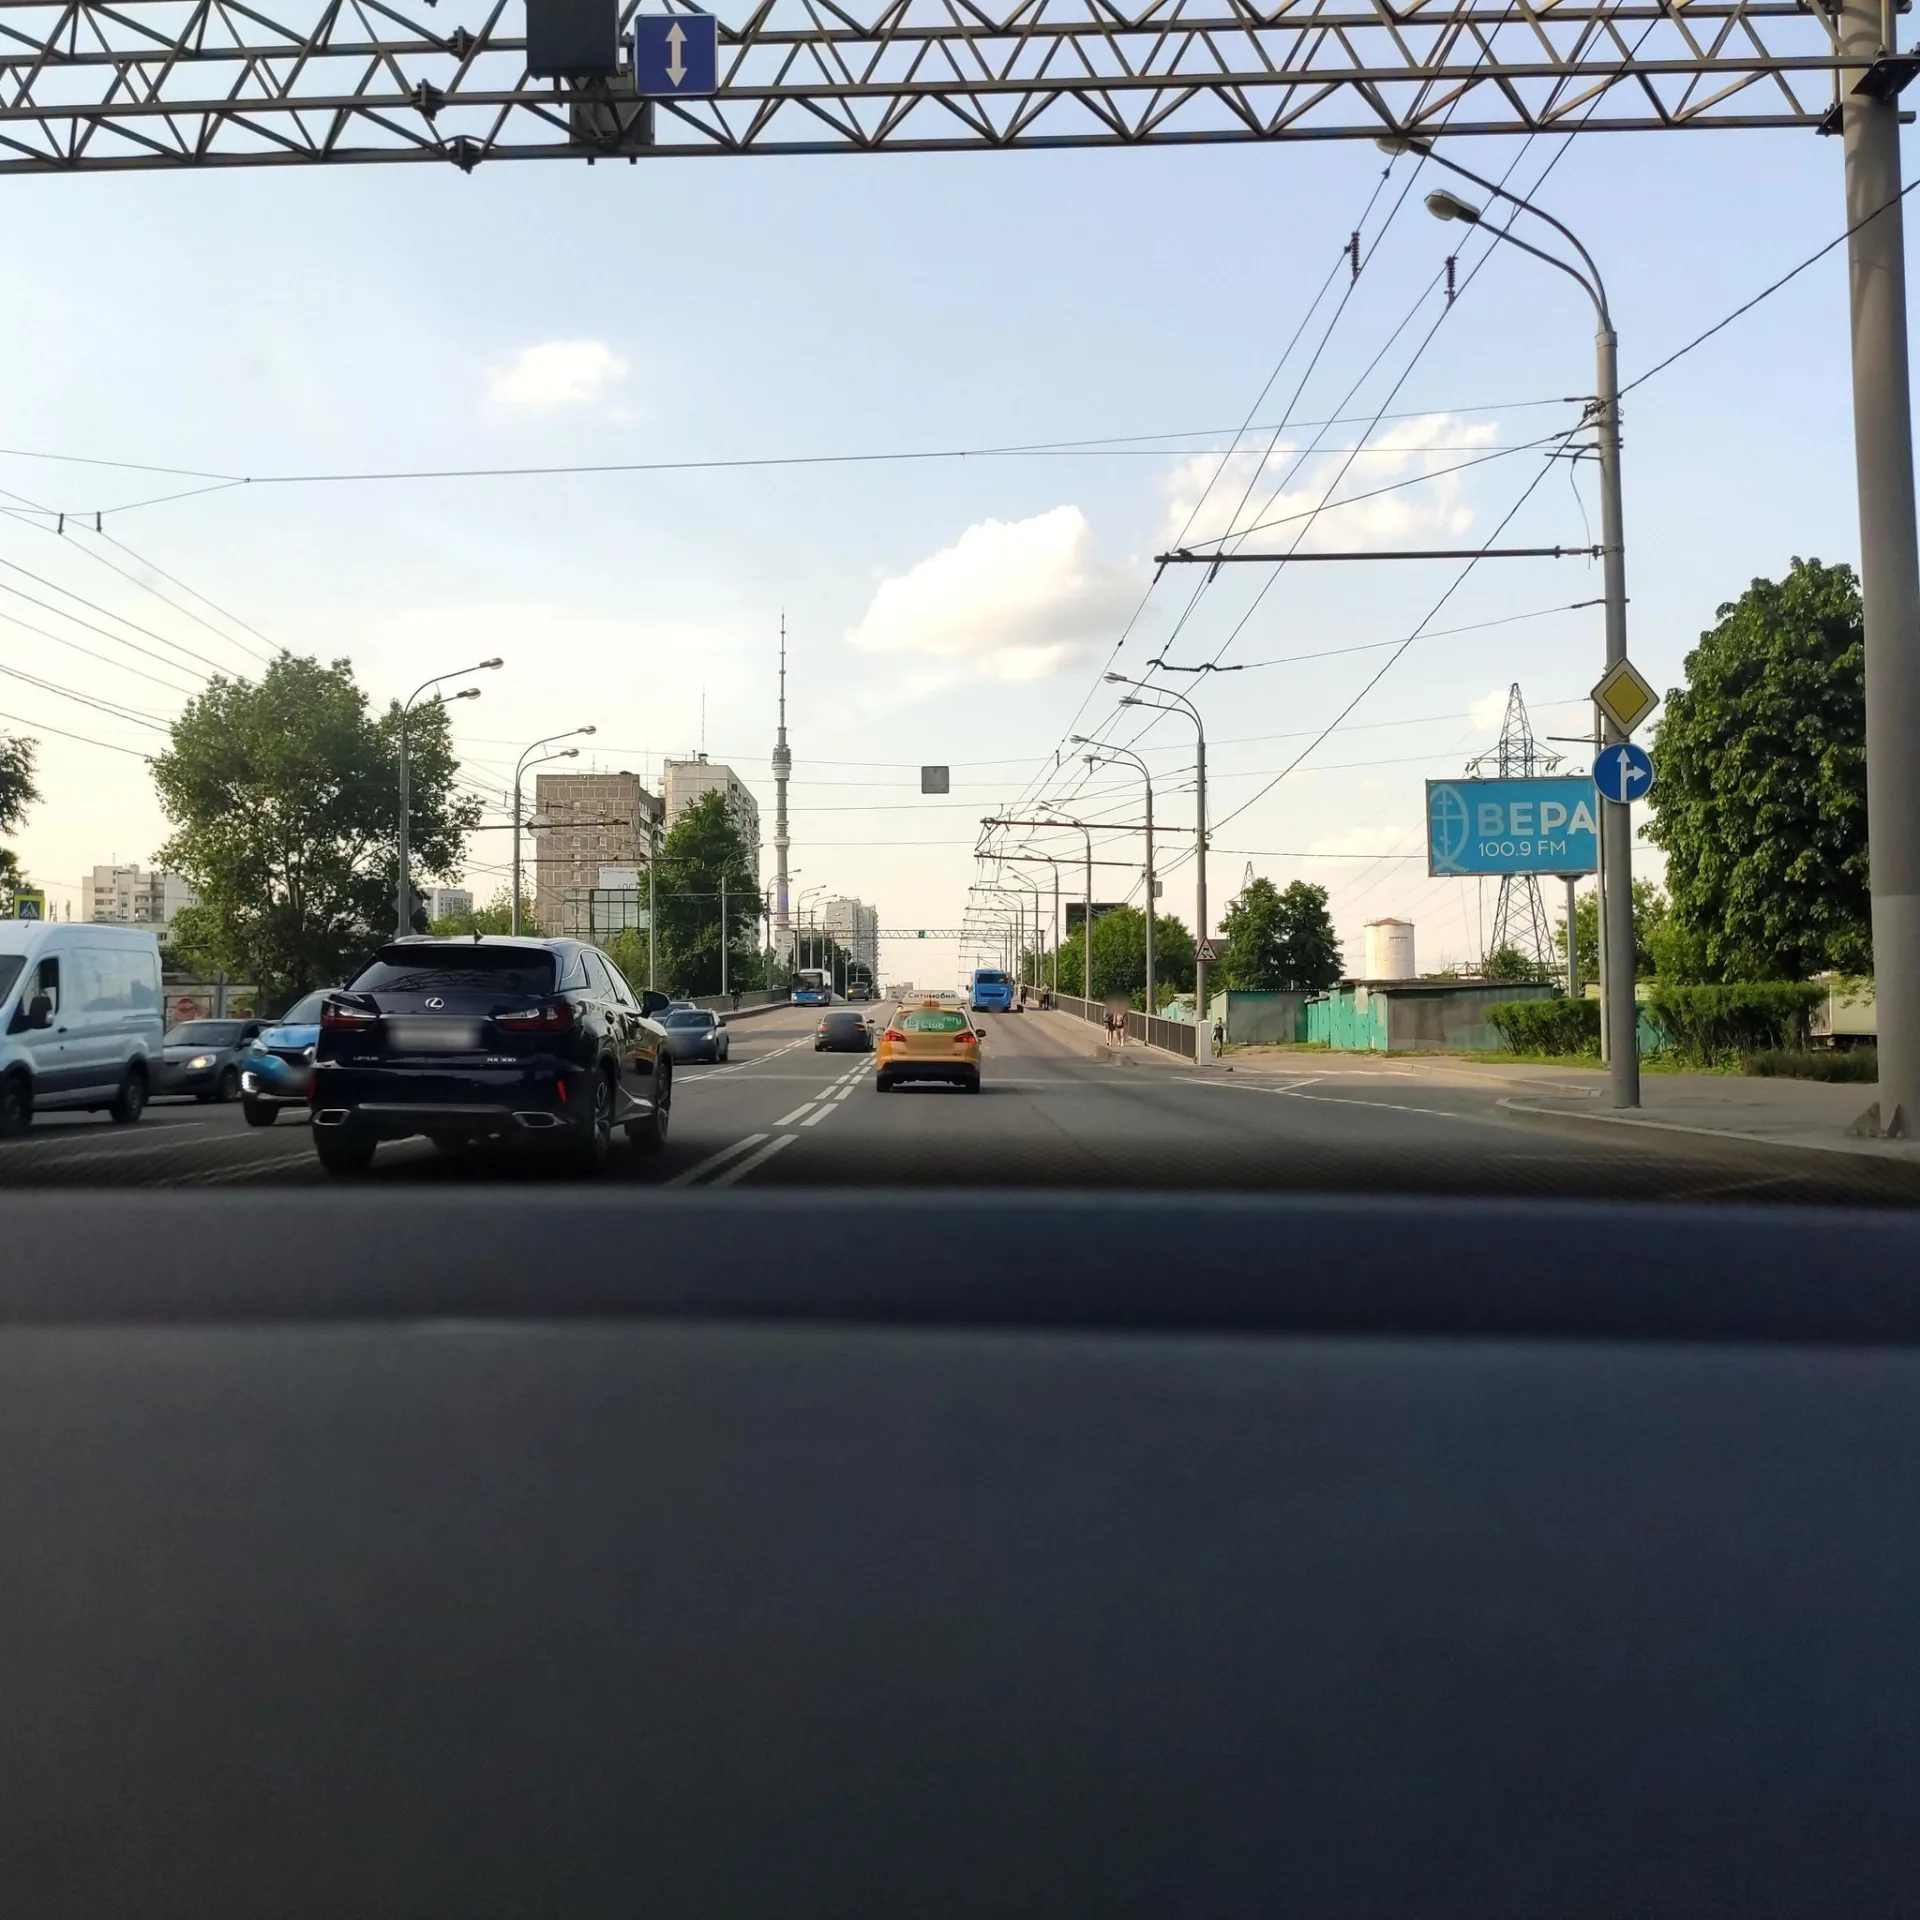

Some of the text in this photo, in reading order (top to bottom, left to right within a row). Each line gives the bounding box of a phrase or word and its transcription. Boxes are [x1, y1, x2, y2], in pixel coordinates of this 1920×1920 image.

[1478, 801, 1597, 836] ВЕРА
[1478, 840, 1566, 857] 100.9 FM
[921, 1021, 944, 1029] Club
